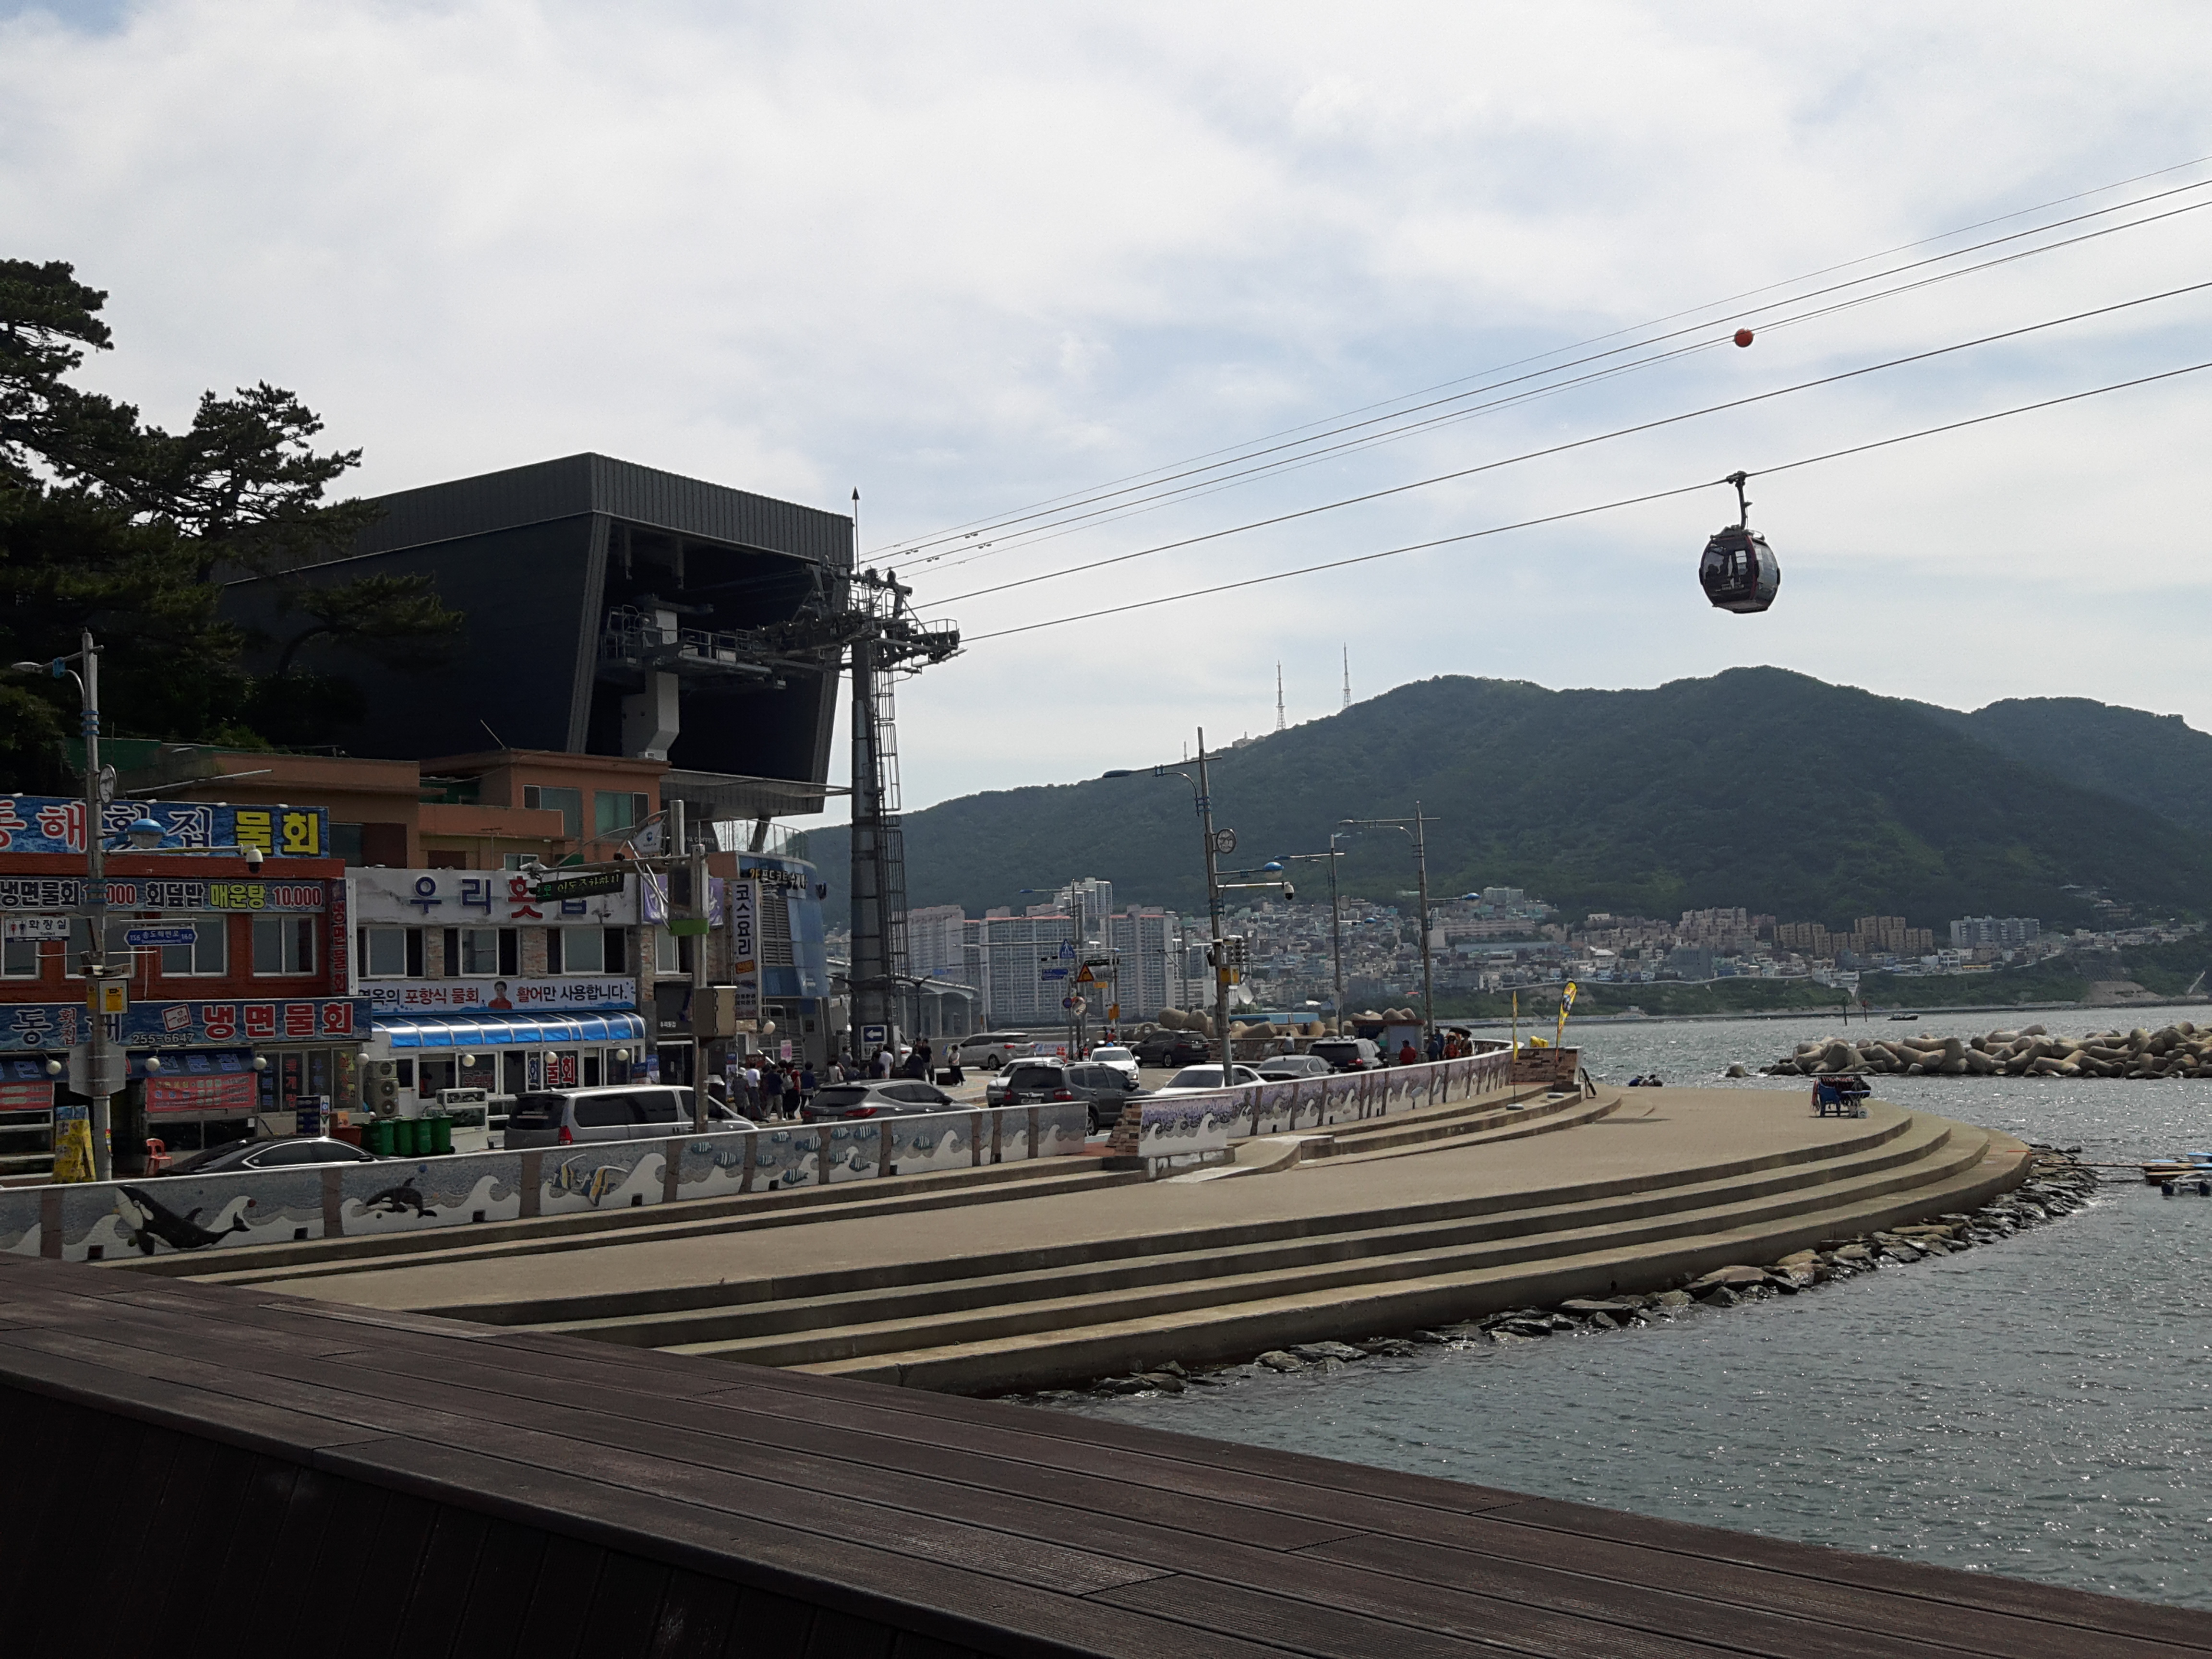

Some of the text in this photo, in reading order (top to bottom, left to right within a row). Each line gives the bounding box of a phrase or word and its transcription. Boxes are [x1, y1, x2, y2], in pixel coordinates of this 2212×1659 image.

[235, 810, 319, 855] 물회
[210, 883, 265, 909] 매운탕
[274, 887, 322, 907] 10,000
[736, 884, 751, 955] 코스요리
[404, 987, 447, 1005] 포항식
[451, 987, 479, 1003] 물회
[516, 986, 556, 1003] 활어만
[560, 984, 627, 1001] 사용합니다.
[203, 1002, 353, 1041] 냉면물회
[132, 1033, 194, 1045] 255-6647
